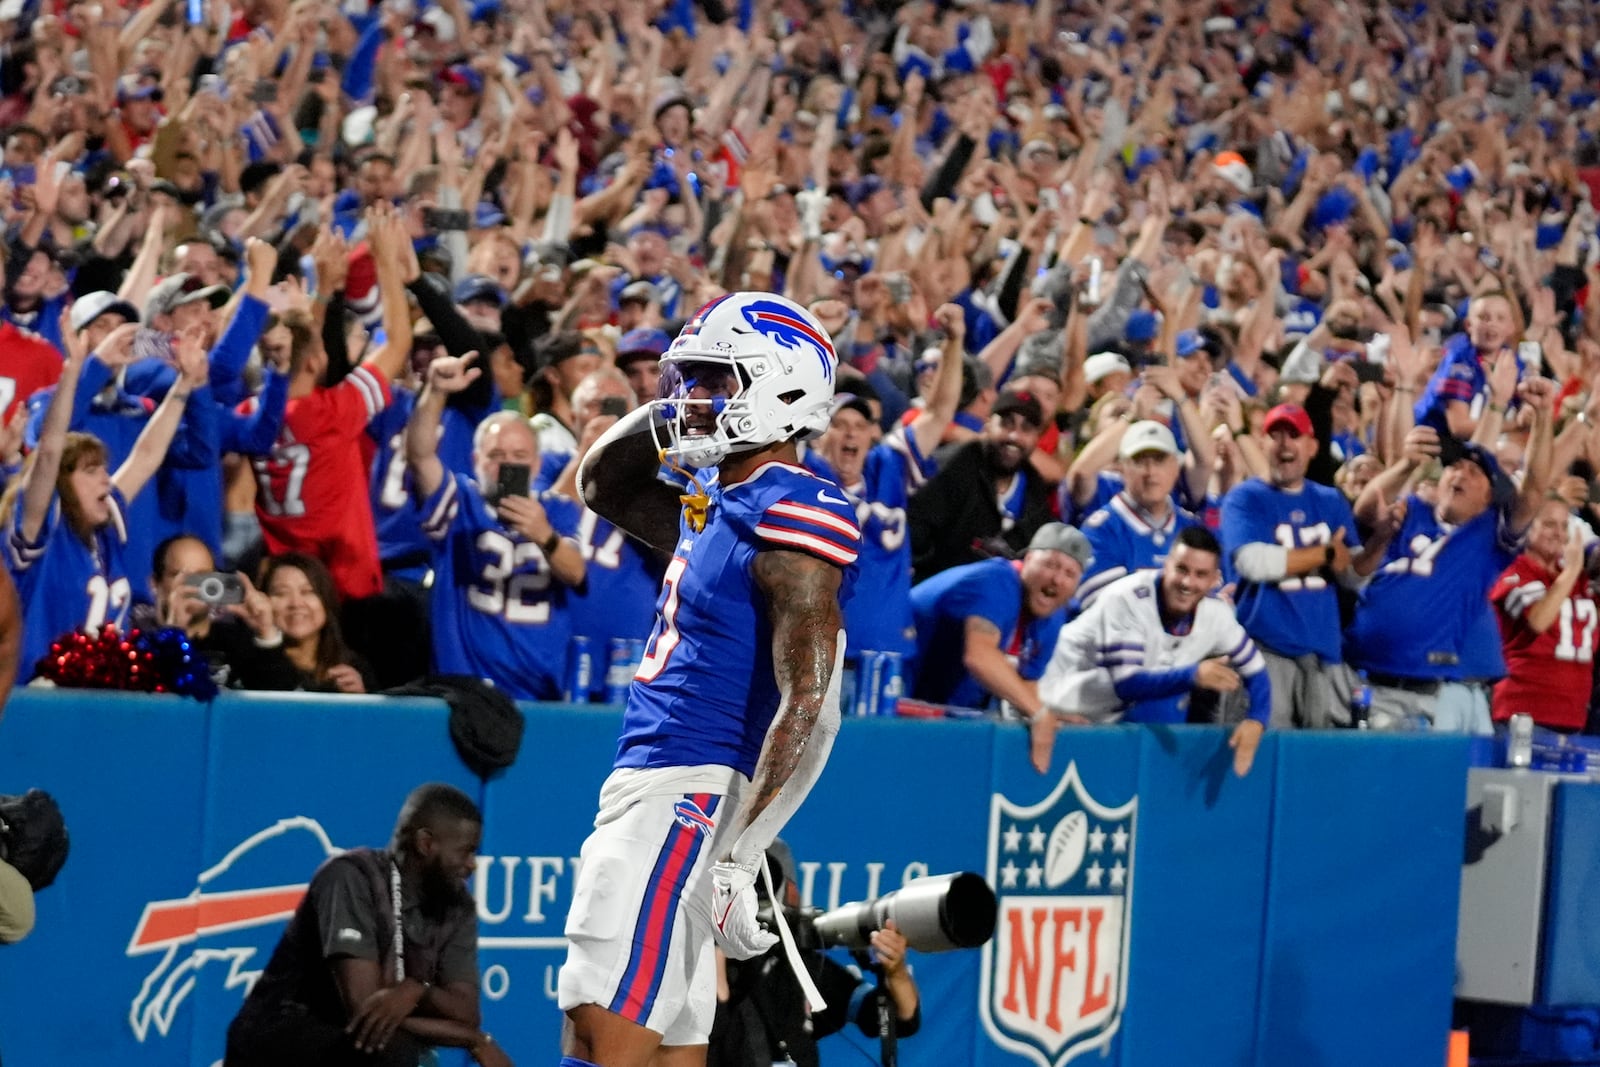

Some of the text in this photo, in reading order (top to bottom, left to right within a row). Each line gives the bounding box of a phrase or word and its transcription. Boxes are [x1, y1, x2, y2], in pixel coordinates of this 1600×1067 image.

[471, 530, 551, 619] 32
[1555, 596, 1598, 663] 17
[1002, 907, 1111, 1034] NFL
